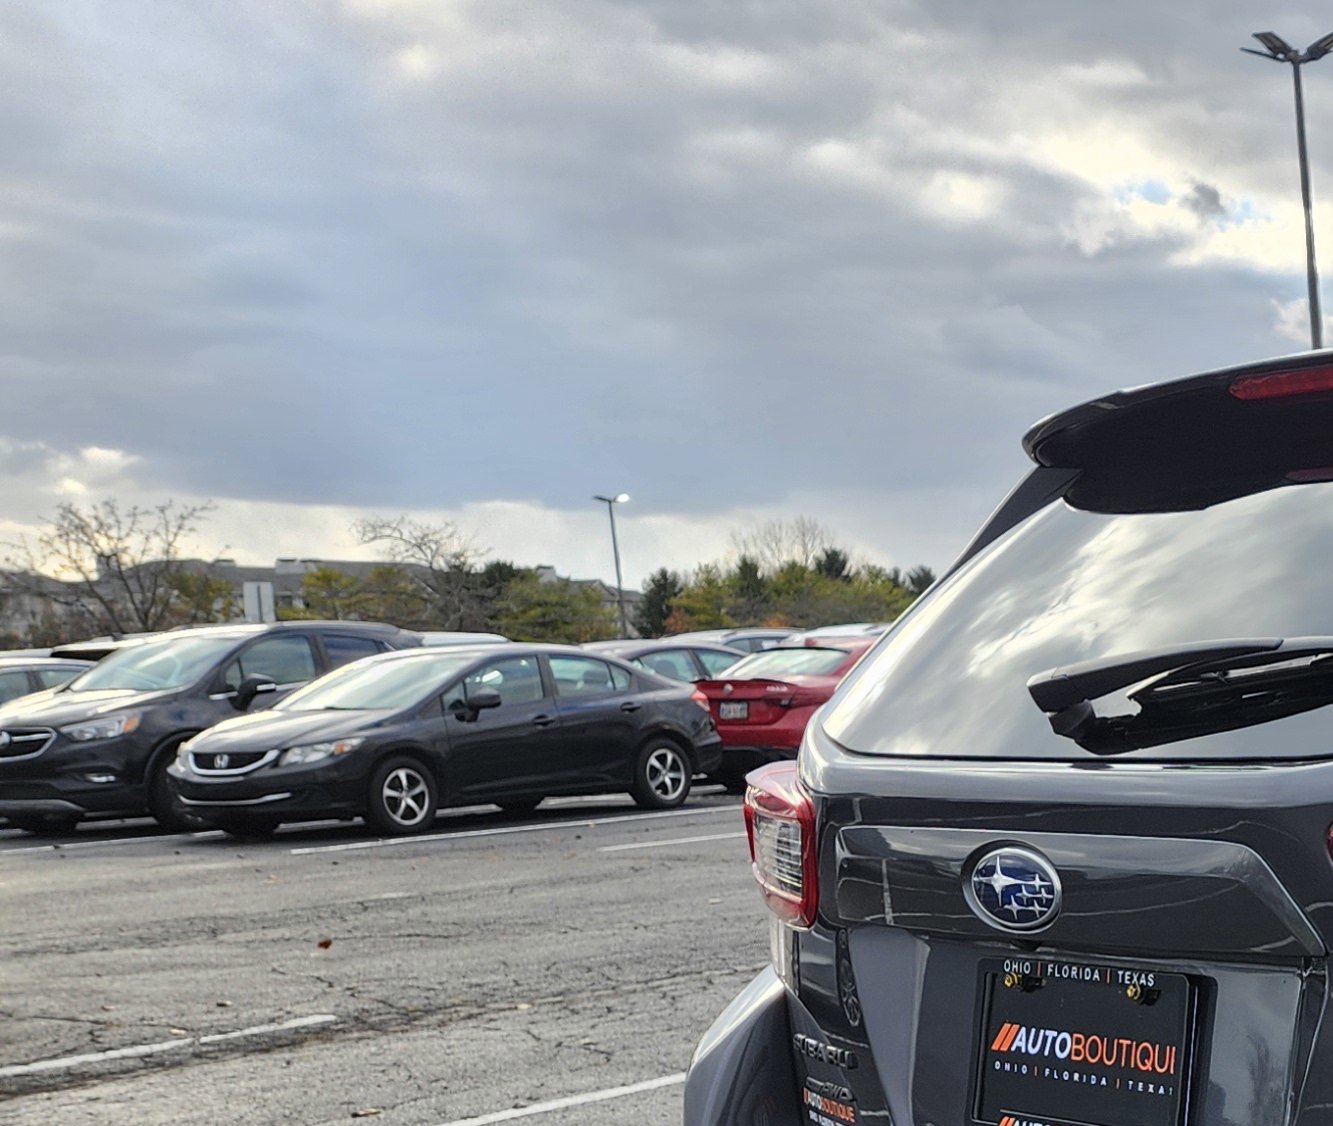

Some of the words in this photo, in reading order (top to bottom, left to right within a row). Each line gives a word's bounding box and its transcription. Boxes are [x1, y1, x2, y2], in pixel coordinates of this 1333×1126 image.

[1003, 958, 1031, 974] OHIO
[1046, 964, 1100, 982] FLORIDA
[1117, 970, 1155, 987] TEXAS
[793, 1032, 859, 1070] SUBARU
[1010, 1026, 1176, 1075] AUTOBOUTIQU
[994, 1061, 1028, 1075] OHIO
[1044, 1068, 1107, 1086] FLORIDA
